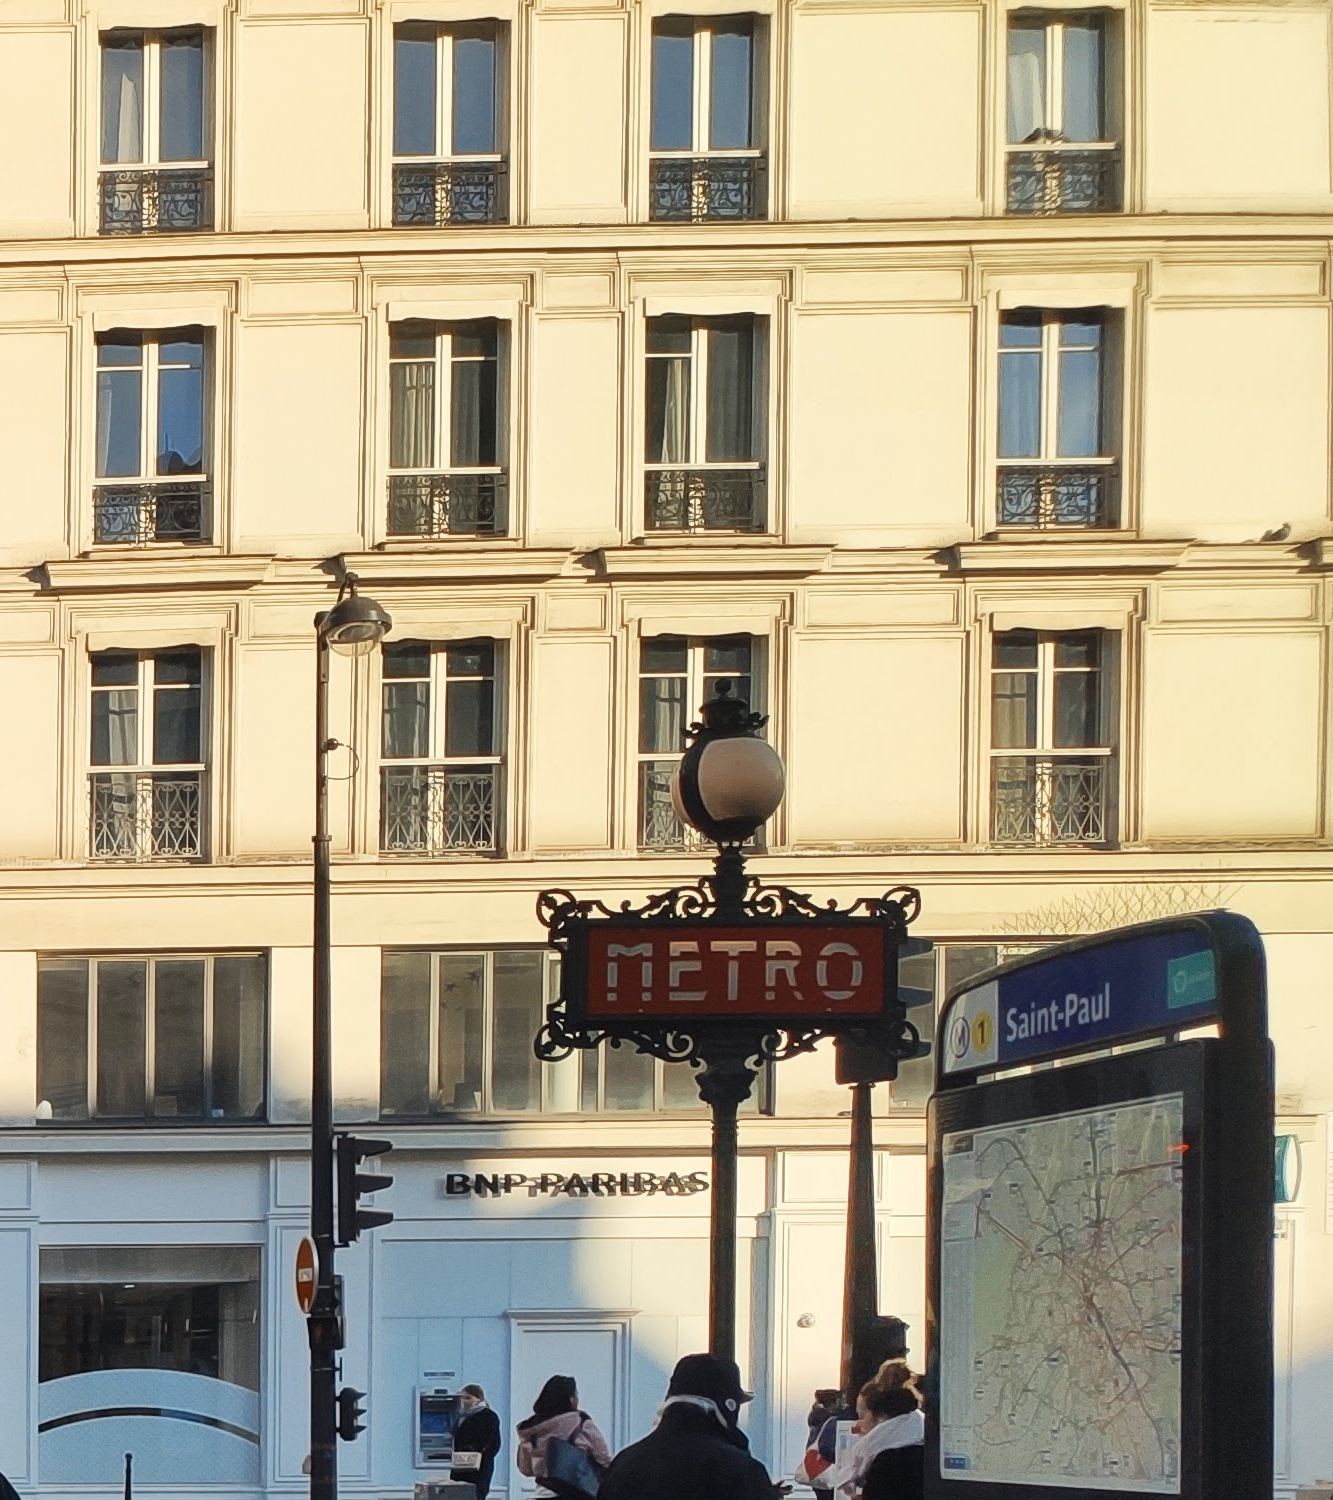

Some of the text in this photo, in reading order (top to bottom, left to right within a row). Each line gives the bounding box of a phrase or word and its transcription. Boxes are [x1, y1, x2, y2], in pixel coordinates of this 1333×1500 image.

[606, 940, 863, 1001] METRO
[1006, 982, 1111, 1043] Saint-Paul
[445, 1171, 711, 1196] BNP PARIBAS
